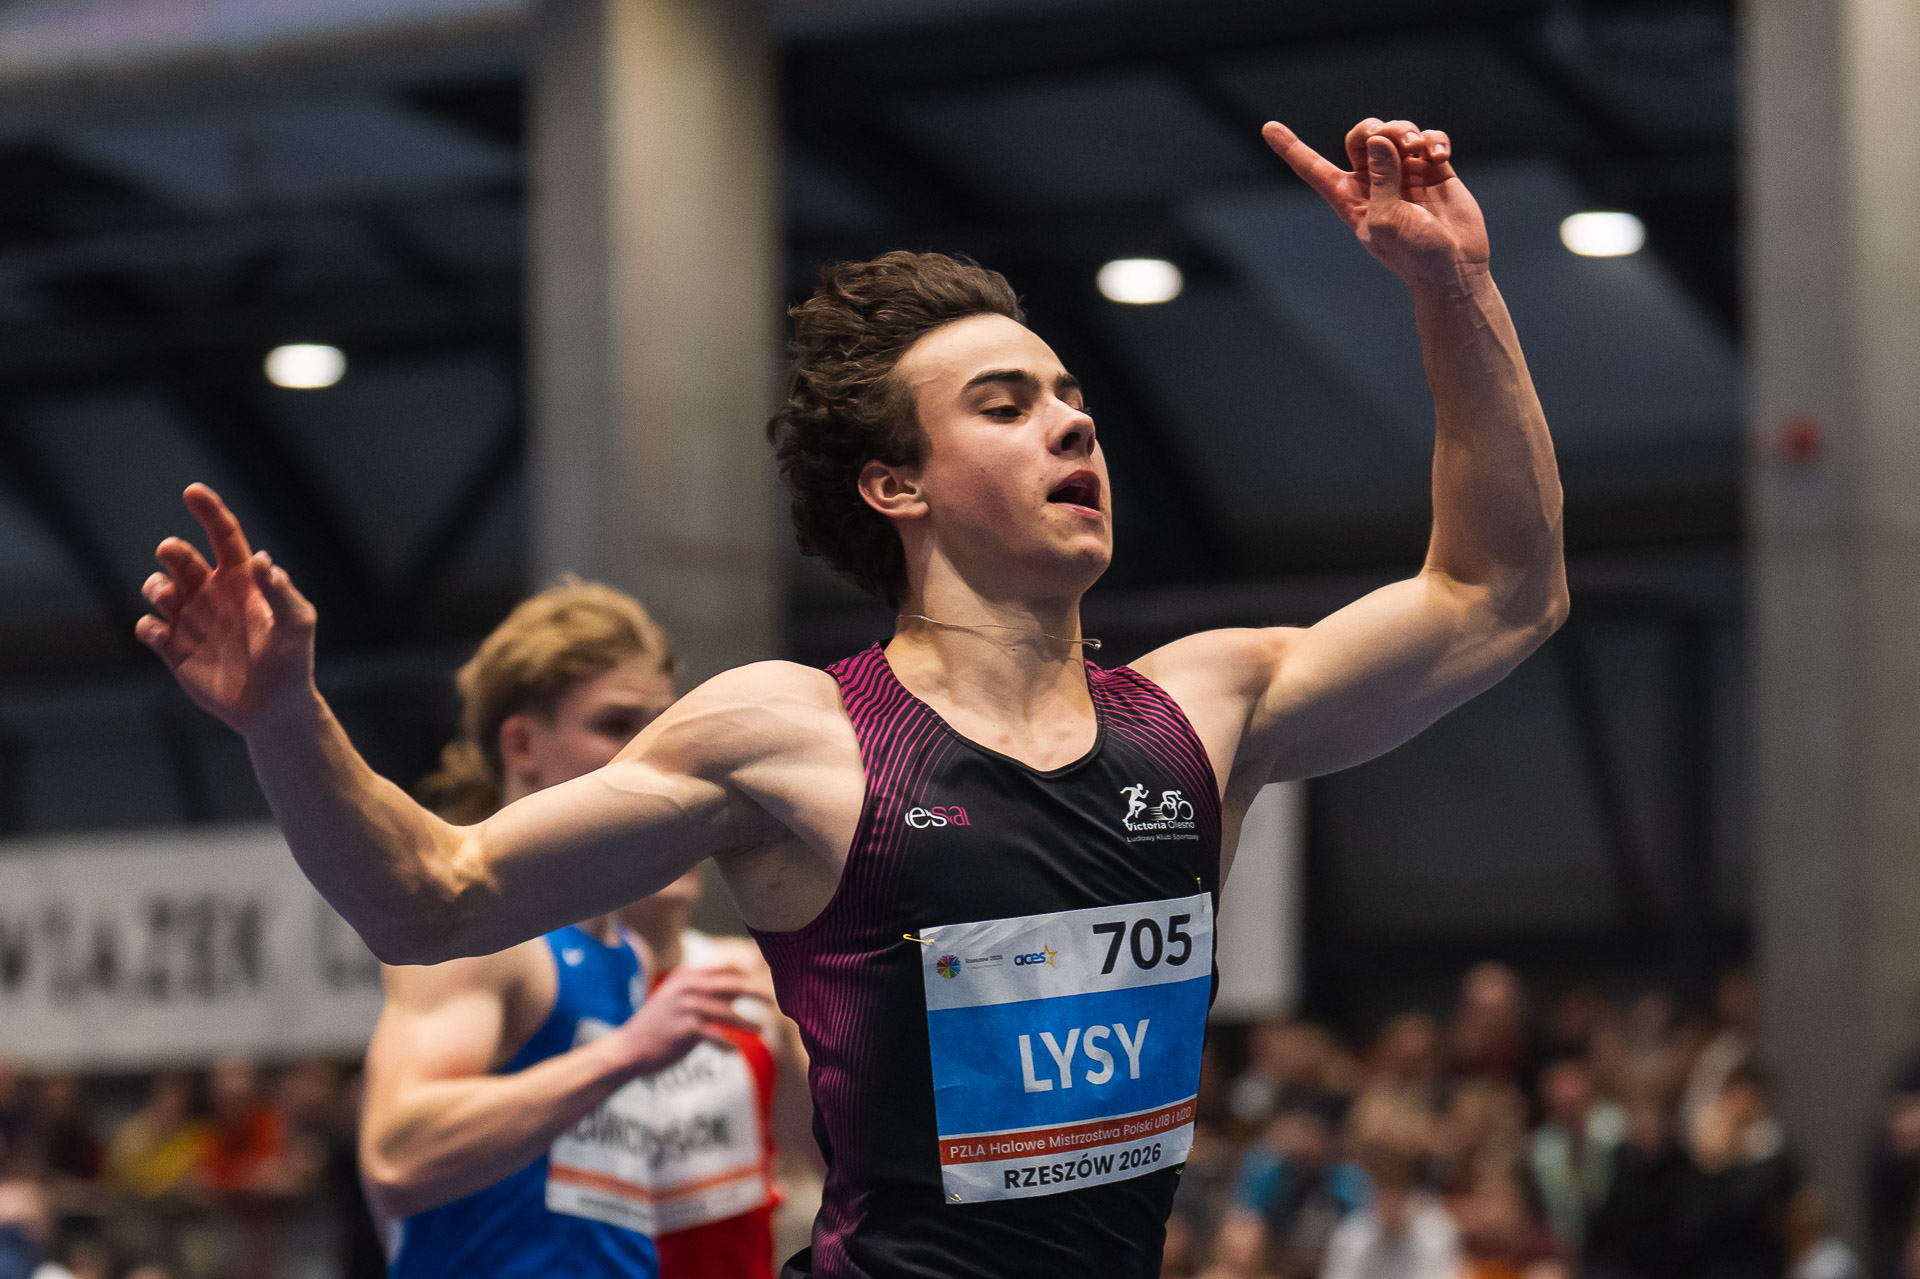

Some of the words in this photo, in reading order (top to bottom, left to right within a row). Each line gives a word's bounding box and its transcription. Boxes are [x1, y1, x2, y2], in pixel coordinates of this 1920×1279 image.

[1125, 820, 1167, 832] Victoria
[1014, 951, 1046, 966] aces
[1092, 913, 1192, 975] 705
[1018, 1019, 1150, 1093] LYSY
[949, 1144, 986, 1159] PZLA
[989, 1139, 1046, 1155] Halowe
[1049, 1127, 1120, 1148] Mistrzostwa
[1123, 1117, 1153, 1136] Polski
[1154, 1113, 1170, 1129] U18
[1171, 1111, 1175, 1124] i
[1176, 1106, 1192, 1122] U20
[1003, 1152, 1115, 1189] RZESZÓW
[1118, 1142, 1162, 1171] 2026
